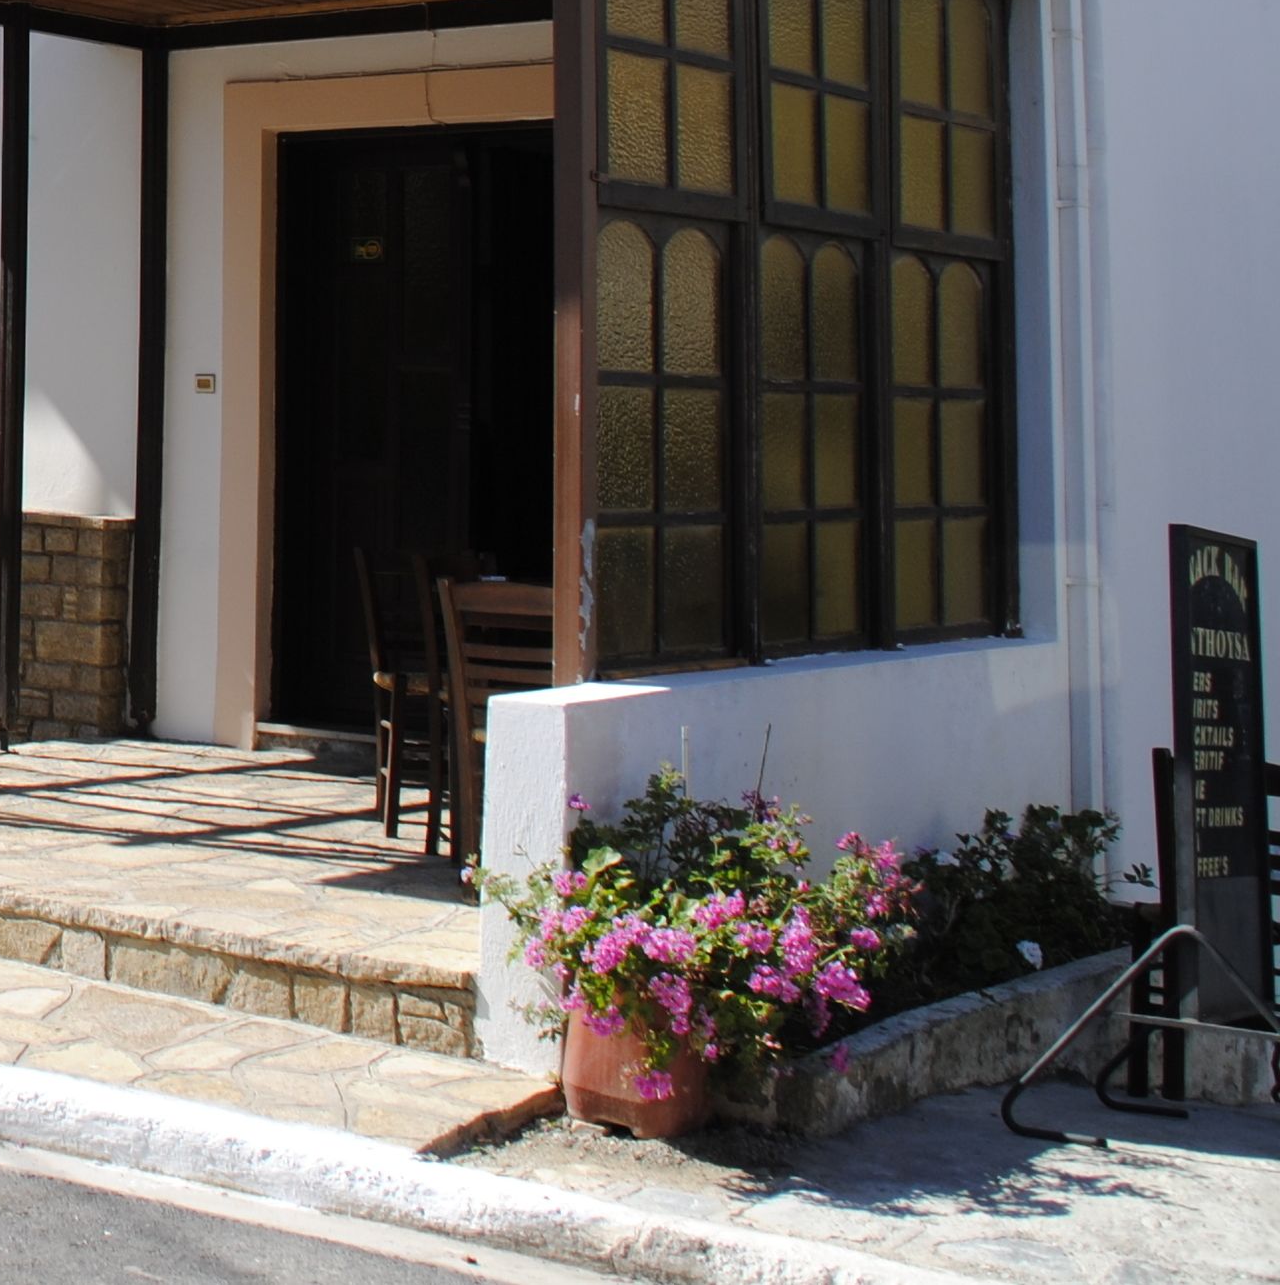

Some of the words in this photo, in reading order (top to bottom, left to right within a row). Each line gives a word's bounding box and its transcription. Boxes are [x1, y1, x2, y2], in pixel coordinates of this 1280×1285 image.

[1192, 671, 1212, 692] ERS
[1192, 698, 1219, 719] IRITS
[1193, 724, 1234, 747] CKTAILS
[1194, 750, 1225, 771] ERITIF
[1195, 807, 1206, 828] FT
[1208, 806, 1244, 827] DRINKS
[1197, 855, 1229, 877] FFEE'S
